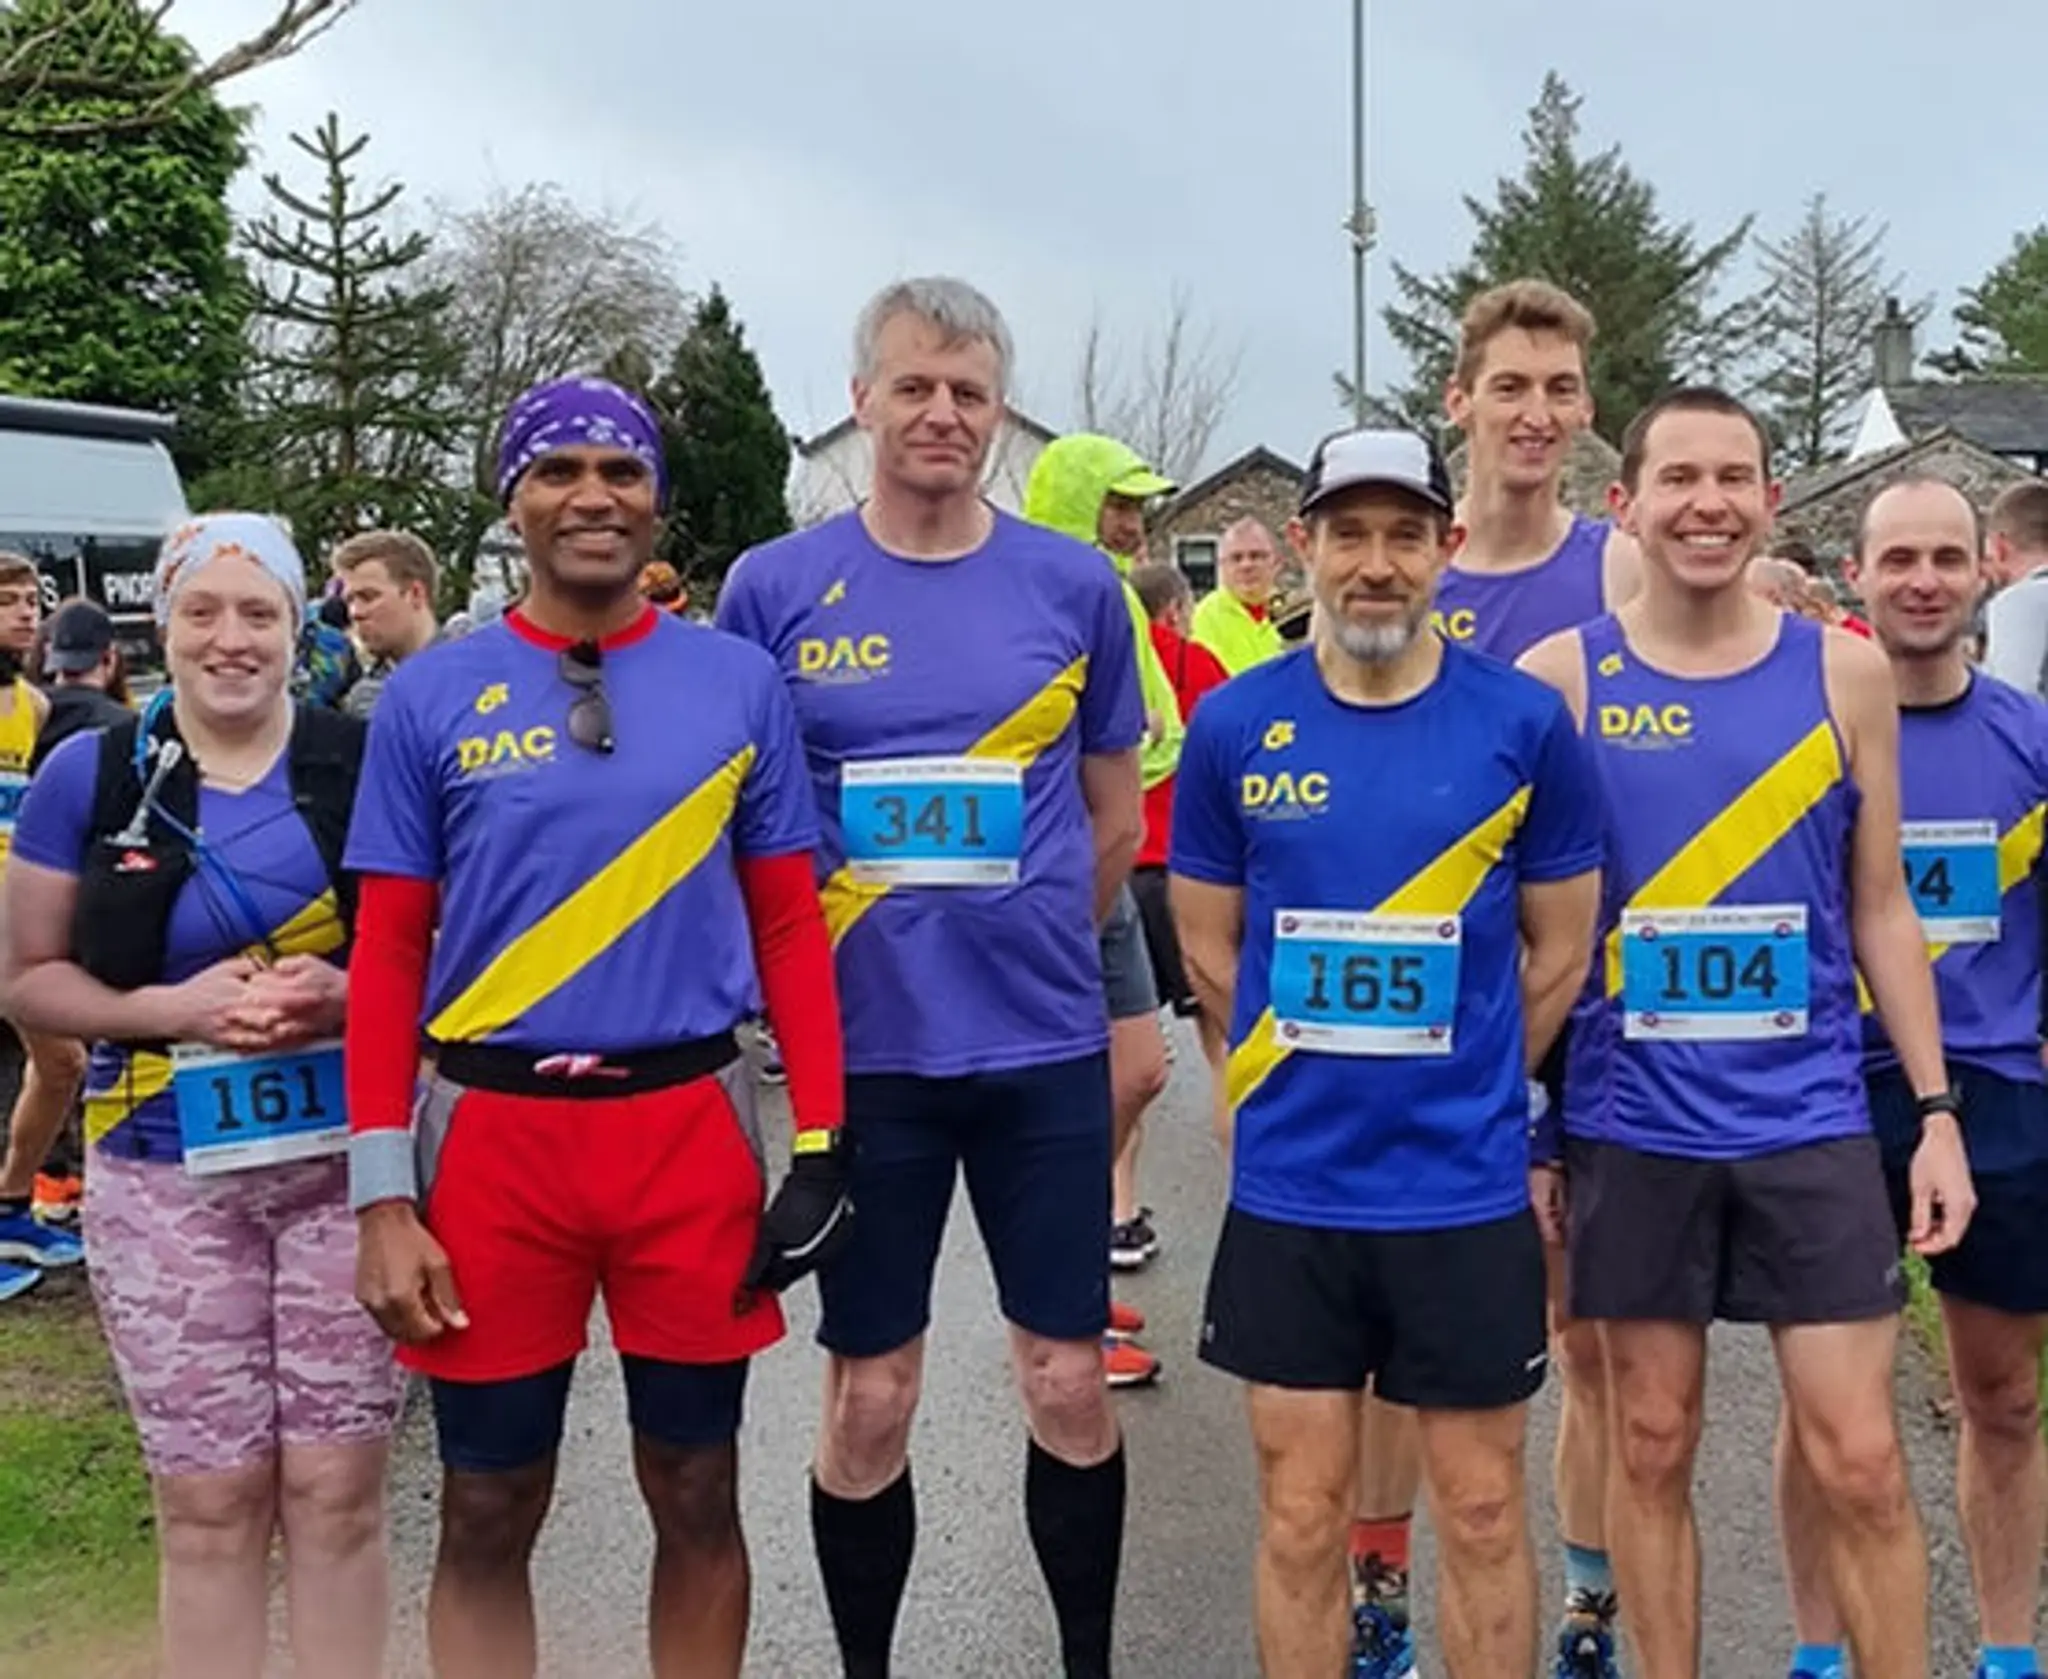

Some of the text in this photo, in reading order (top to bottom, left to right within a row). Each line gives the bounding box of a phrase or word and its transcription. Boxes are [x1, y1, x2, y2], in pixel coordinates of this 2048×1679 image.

[799, 633, 888, 673] DAC
[1599, 704, 1690, 737] DAC
[458, 725, 556, 771] DAC
[1242, 771, 1329, 807] DAC
[872, 794, 986, 847] 341
[1304, 952, 1424, 1013] 165
[1661, 944, 1778, 999] 104
[211, 1064, 327, 1133] 161
